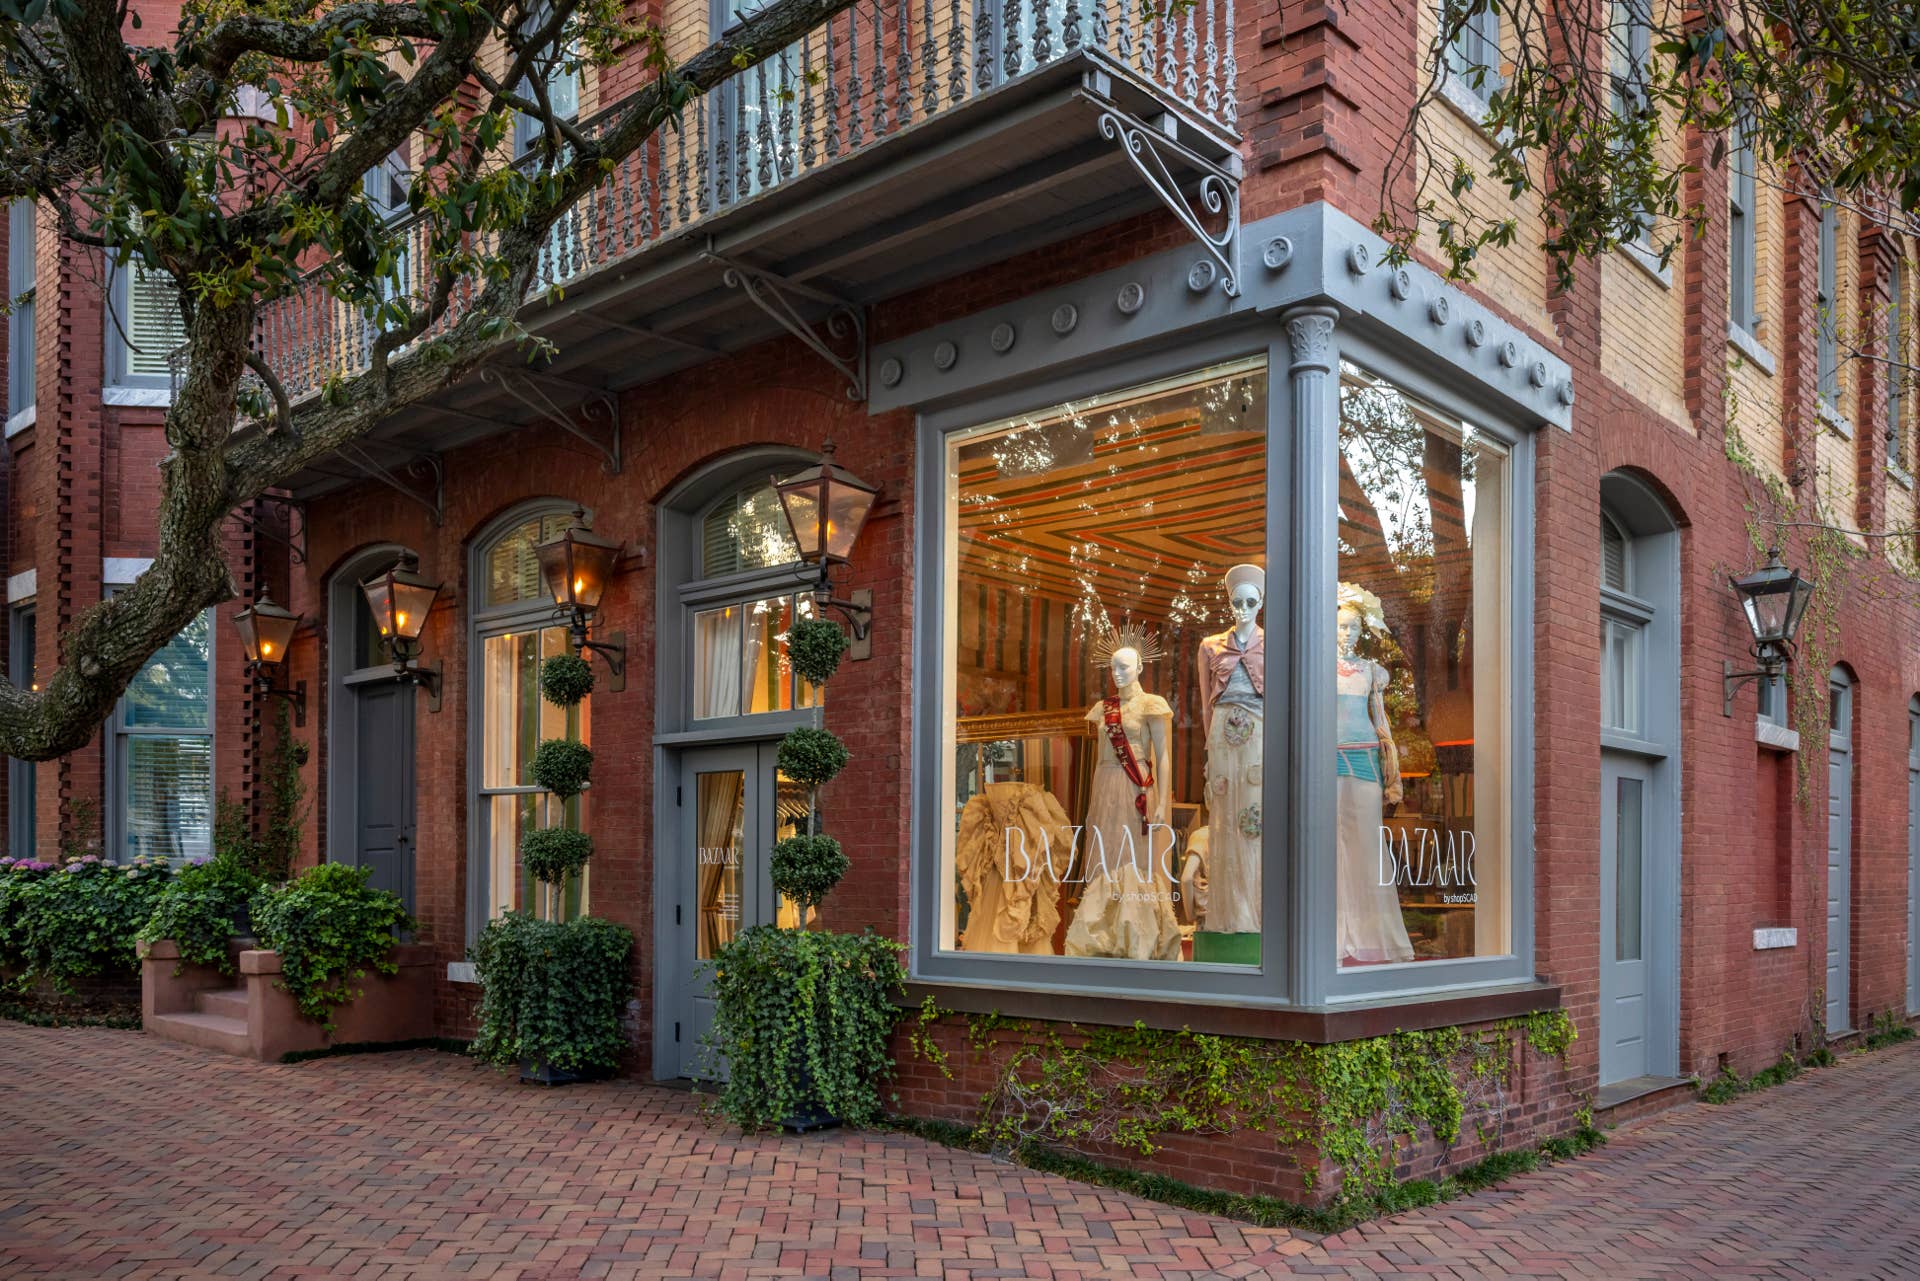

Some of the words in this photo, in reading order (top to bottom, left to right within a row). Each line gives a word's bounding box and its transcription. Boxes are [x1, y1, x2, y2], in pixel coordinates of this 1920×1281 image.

[699, 847, 739, 865] BAZAAR
[1003, 823, 1181, 884] BAZAAR
[1378, 825, 1478, 886] BAZAAR
